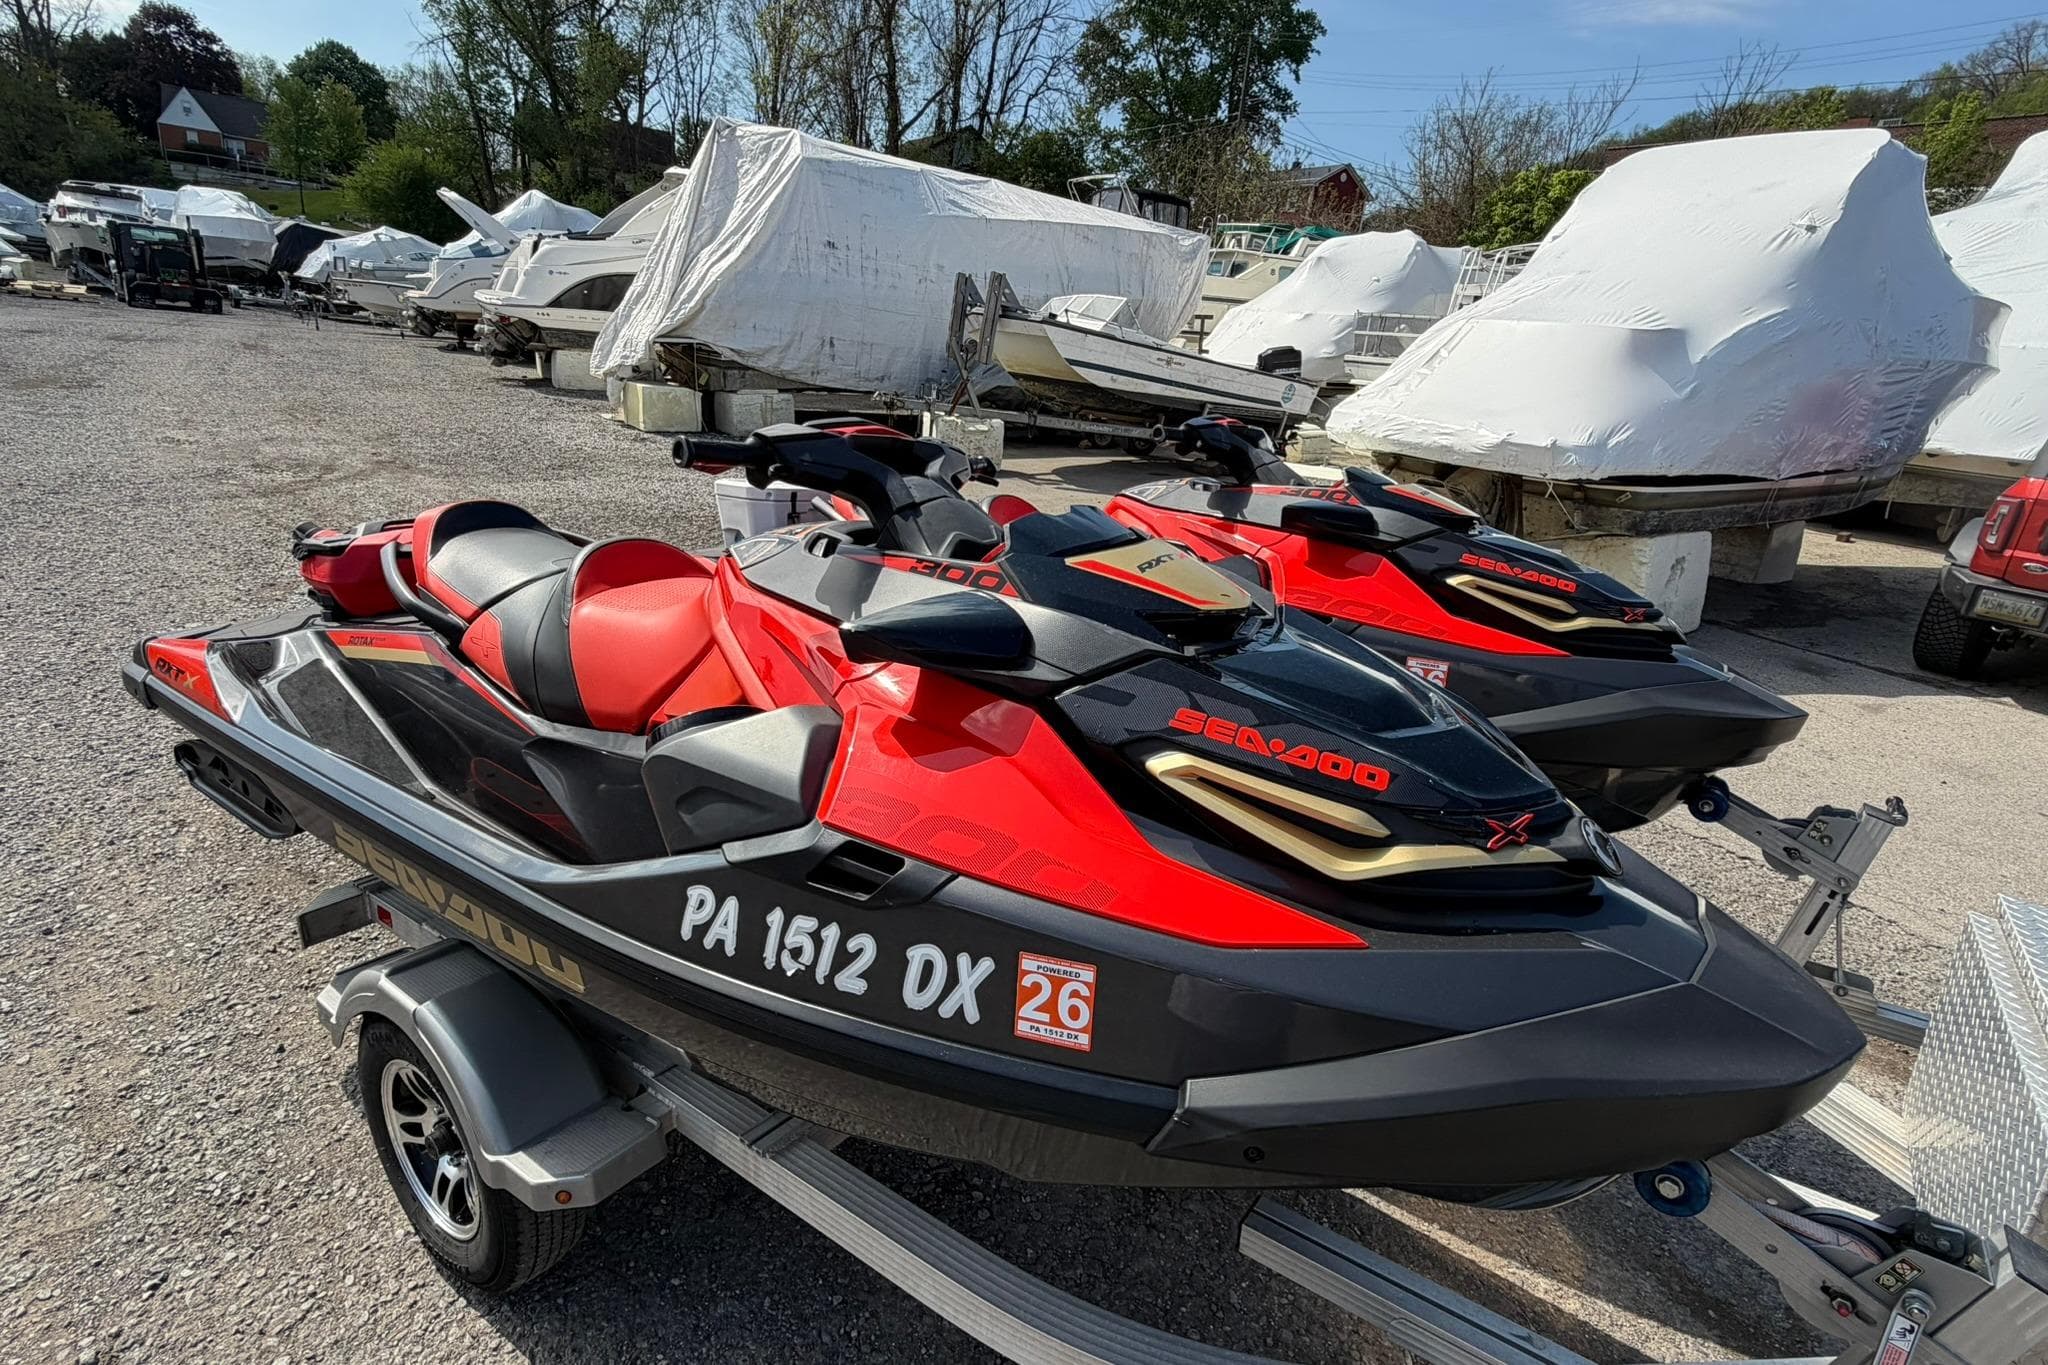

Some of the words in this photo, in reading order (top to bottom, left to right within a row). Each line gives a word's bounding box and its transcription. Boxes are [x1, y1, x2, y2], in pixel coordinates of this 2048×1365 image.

[909, 558, 1007, 593] 300
[1136, 554, 1175, 574] RXT
[680, 885, 740, 957] PA
[762, 906, 878, 996] 1512
[902, 944, 996, 1025] DX
[1036, 964, 1081, 979] POWERED
[1018, 973, 1091, 1029] 26
[1029, 1024, 1041, 1033] PA
[1044, 1028, 1064, 1038] 1512
[1066, 1032, 1079, 1041] DX
